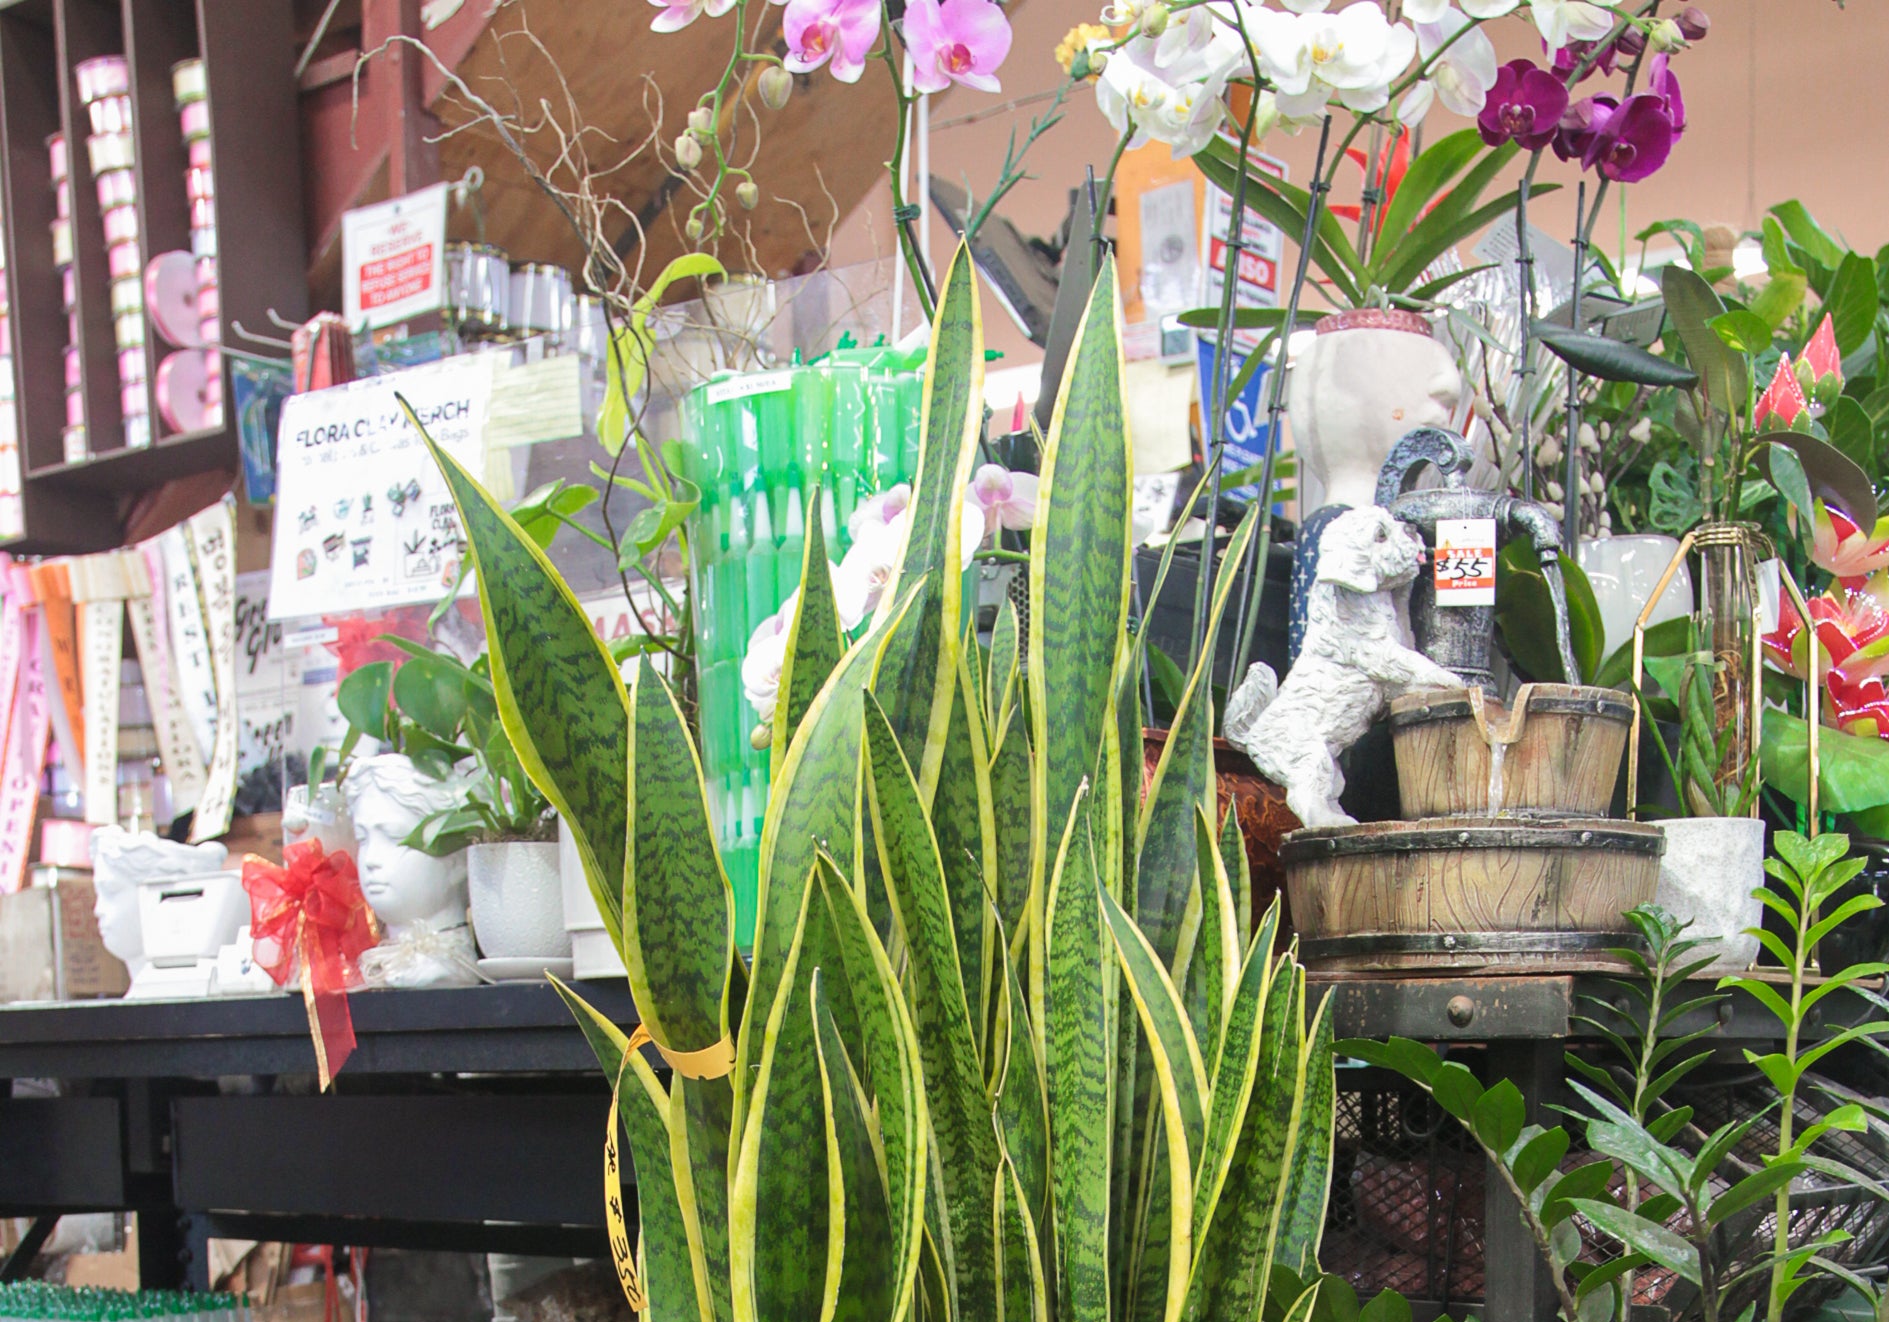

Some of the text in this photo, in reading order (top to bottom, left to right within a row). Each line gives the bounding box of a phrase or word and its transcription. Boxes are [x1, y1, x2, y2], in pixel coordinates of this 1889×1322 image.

[1216, 244, 1270, 285] AISO
[1446, 549, 1483, 559] SALE
[1436, 556, 1489, 580] $55
